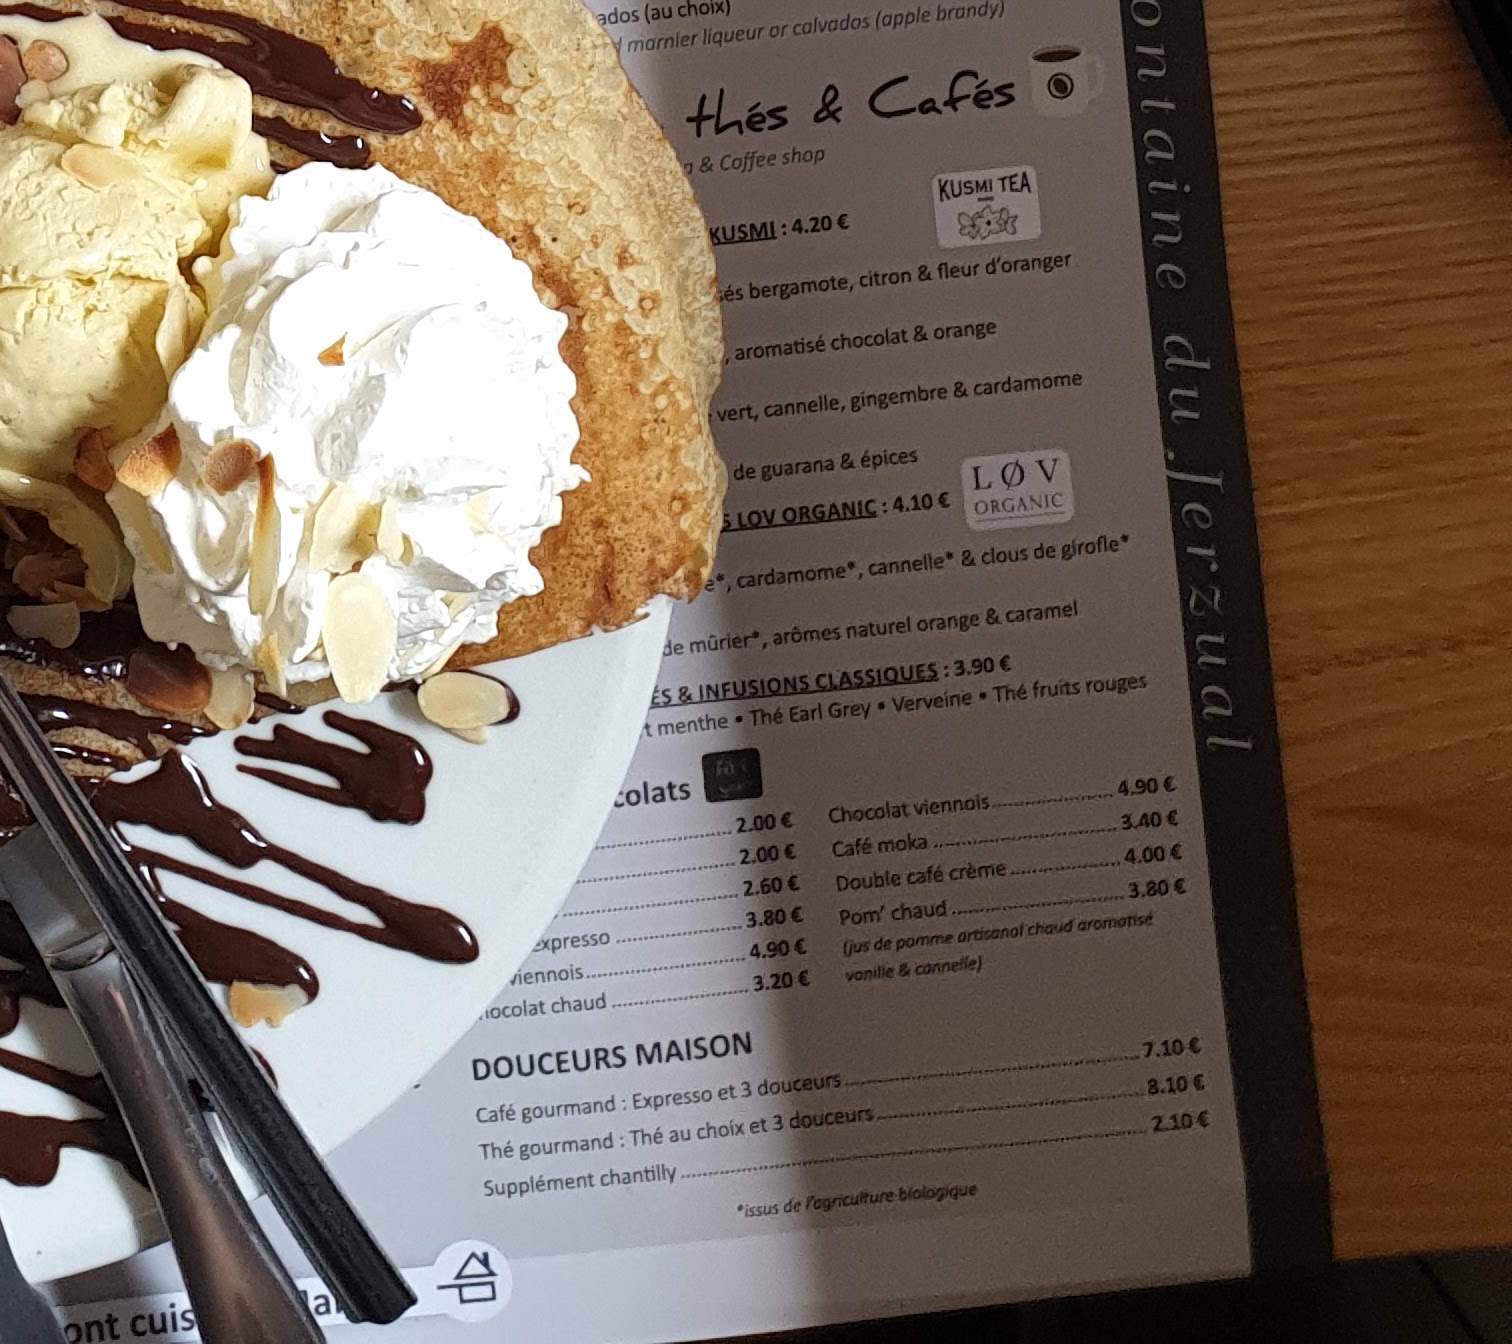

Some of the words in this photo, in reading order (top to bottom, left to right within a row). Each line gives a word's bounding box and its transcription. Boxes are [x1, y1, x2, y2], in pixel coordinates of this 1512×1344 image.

[685, 87, 789, 139] thés
[813, 83, 843, 125] &
[867, 69, 1016, 119] Cafés
[937, 178, 995, 203] KUSMI
[997, 171, 1032, 194] TEA
[708, 220, 778, 247] KUSMI
[791, 215, 833, 235] 4.20
[836, 213, 850, 231] €
[748, 275, 854, 301] bergamote,
[859, 270, 912, 288] citron
[917, 264, 933, 282] &
[937, 261, 980, 280] fleur
[734, 334, 826, 361] aromatisé
[830, 328, 909, 351] chocolat
[913, 324, 929, 343] &
[933, 321, 997, 341] orange
[1163, 334, 1211, 424] du
[737, 507, 779, 529] LOV
[784, 499, 877, 525] ORGANIC
[892, 493, 935, 514] 4.10
[937, 491, 951, 509] €
[973, 491, 1063, 515] ORGANIC
[1165, 449, 1253, 750] Jerzual
[698, 672, 810, 700] INFUSIONS
[815, 664, 938, 692] CLASSIQUES
[953, 657, 996, 678] 3.90
[999, 654, 1012, 673] €
[1117, 777, 1159, 797] 4.90
[1162, 775, 1177, 793] €
[828, 800, 909, 824] Chocolat
[913, 793, 990, 816] viennois
[471, 1045, 627, 1081] DOUCEURS
[635, 1031, 753, 1067] MAISON
[1142, 1038, 1185, 1060] 7.10
[1186, 1036, 1203, 1056] €
[475, 1103, 517, 1124] Café
[521, 1094, 617, 1125] gourmand
[632, 1089, 713, 1111] Expresso
[717, 1084, 738, 1101] et
[741, 1081, 752, 1098] 3
[757, 1073, 841, 1097] douceurs
[483, 1172, 596, 1199] Supplément
[599, 1163, 677, 1187] chantilly
